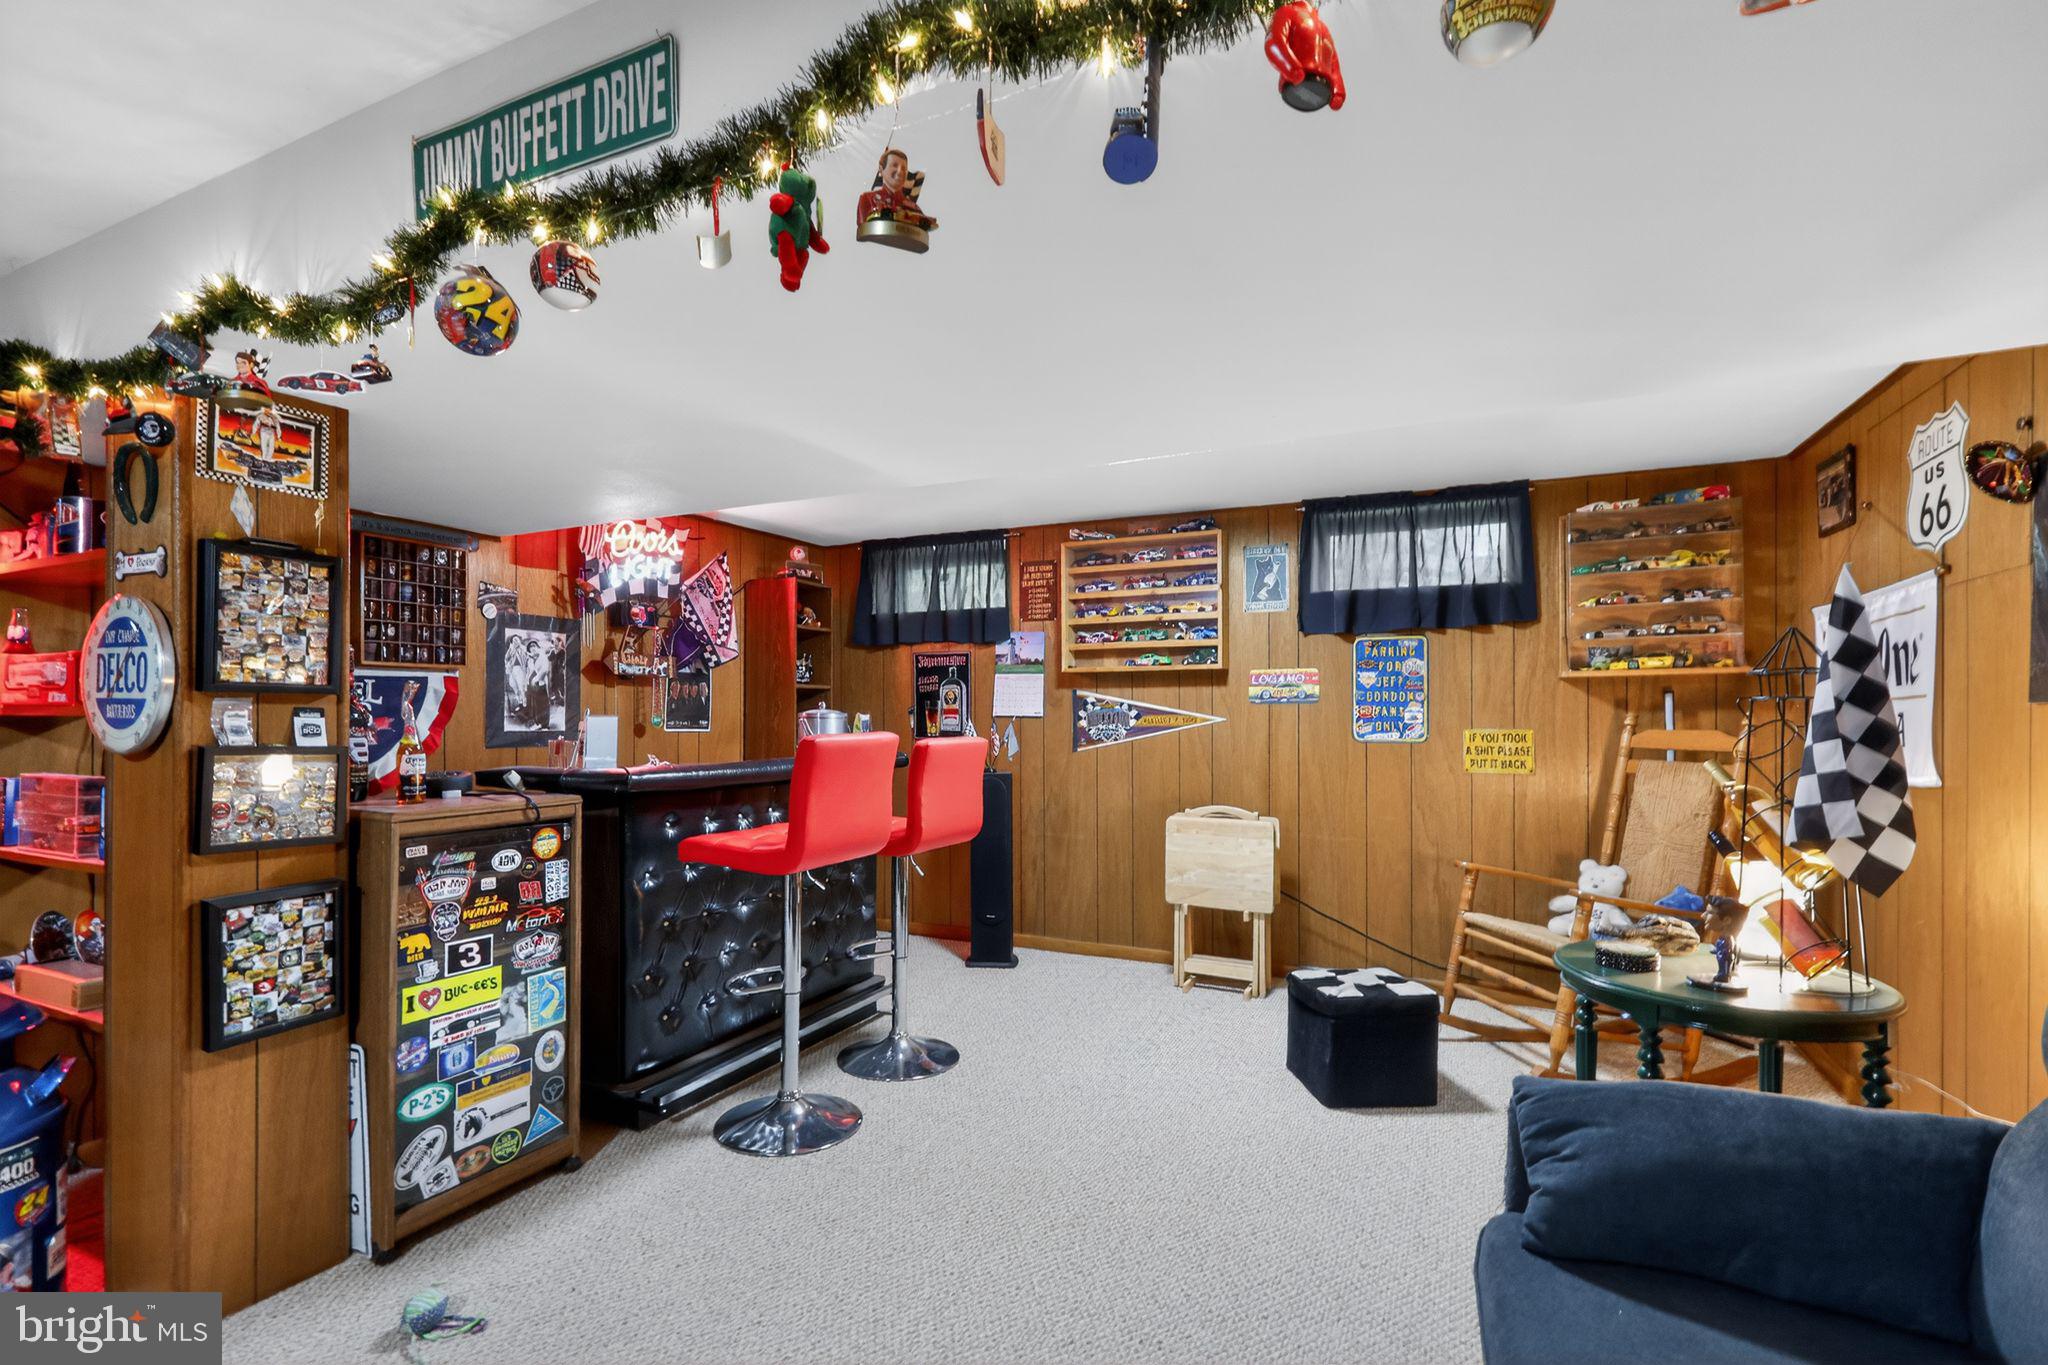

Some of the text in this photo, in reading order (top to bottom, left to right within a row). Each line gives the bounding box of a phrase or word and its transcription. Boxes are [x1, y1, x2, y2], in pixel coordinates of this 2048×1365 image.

[419, 51, 667, 210] JIMMY BUFFETT DRIVE
[1917, 420, 1954, 462] ROUTE
[1925, 461, 1945, 484] US
[1920, 484, 1951, 537] 66
[604, 520, 684, 558] Coors
[1365, 646, 1415, 657] PARKING
[96, 652, 149, 694] DELCO
[1366, 691, 1415, 702] GORDON
[1375, 721, 1405, 732] ONLY
[1469, 733, 1528, 743] IF YOU TOOK
[1465, 746, 1472, 755] A
[1475, 746, 1495, 756] SHIT
[1470, 759, 1527, 769] PUT IT BACK
[458, 942, 482, 968] 3
[406, 995, 415, 1014] I
[19, 1184, 50, 1218] 24
